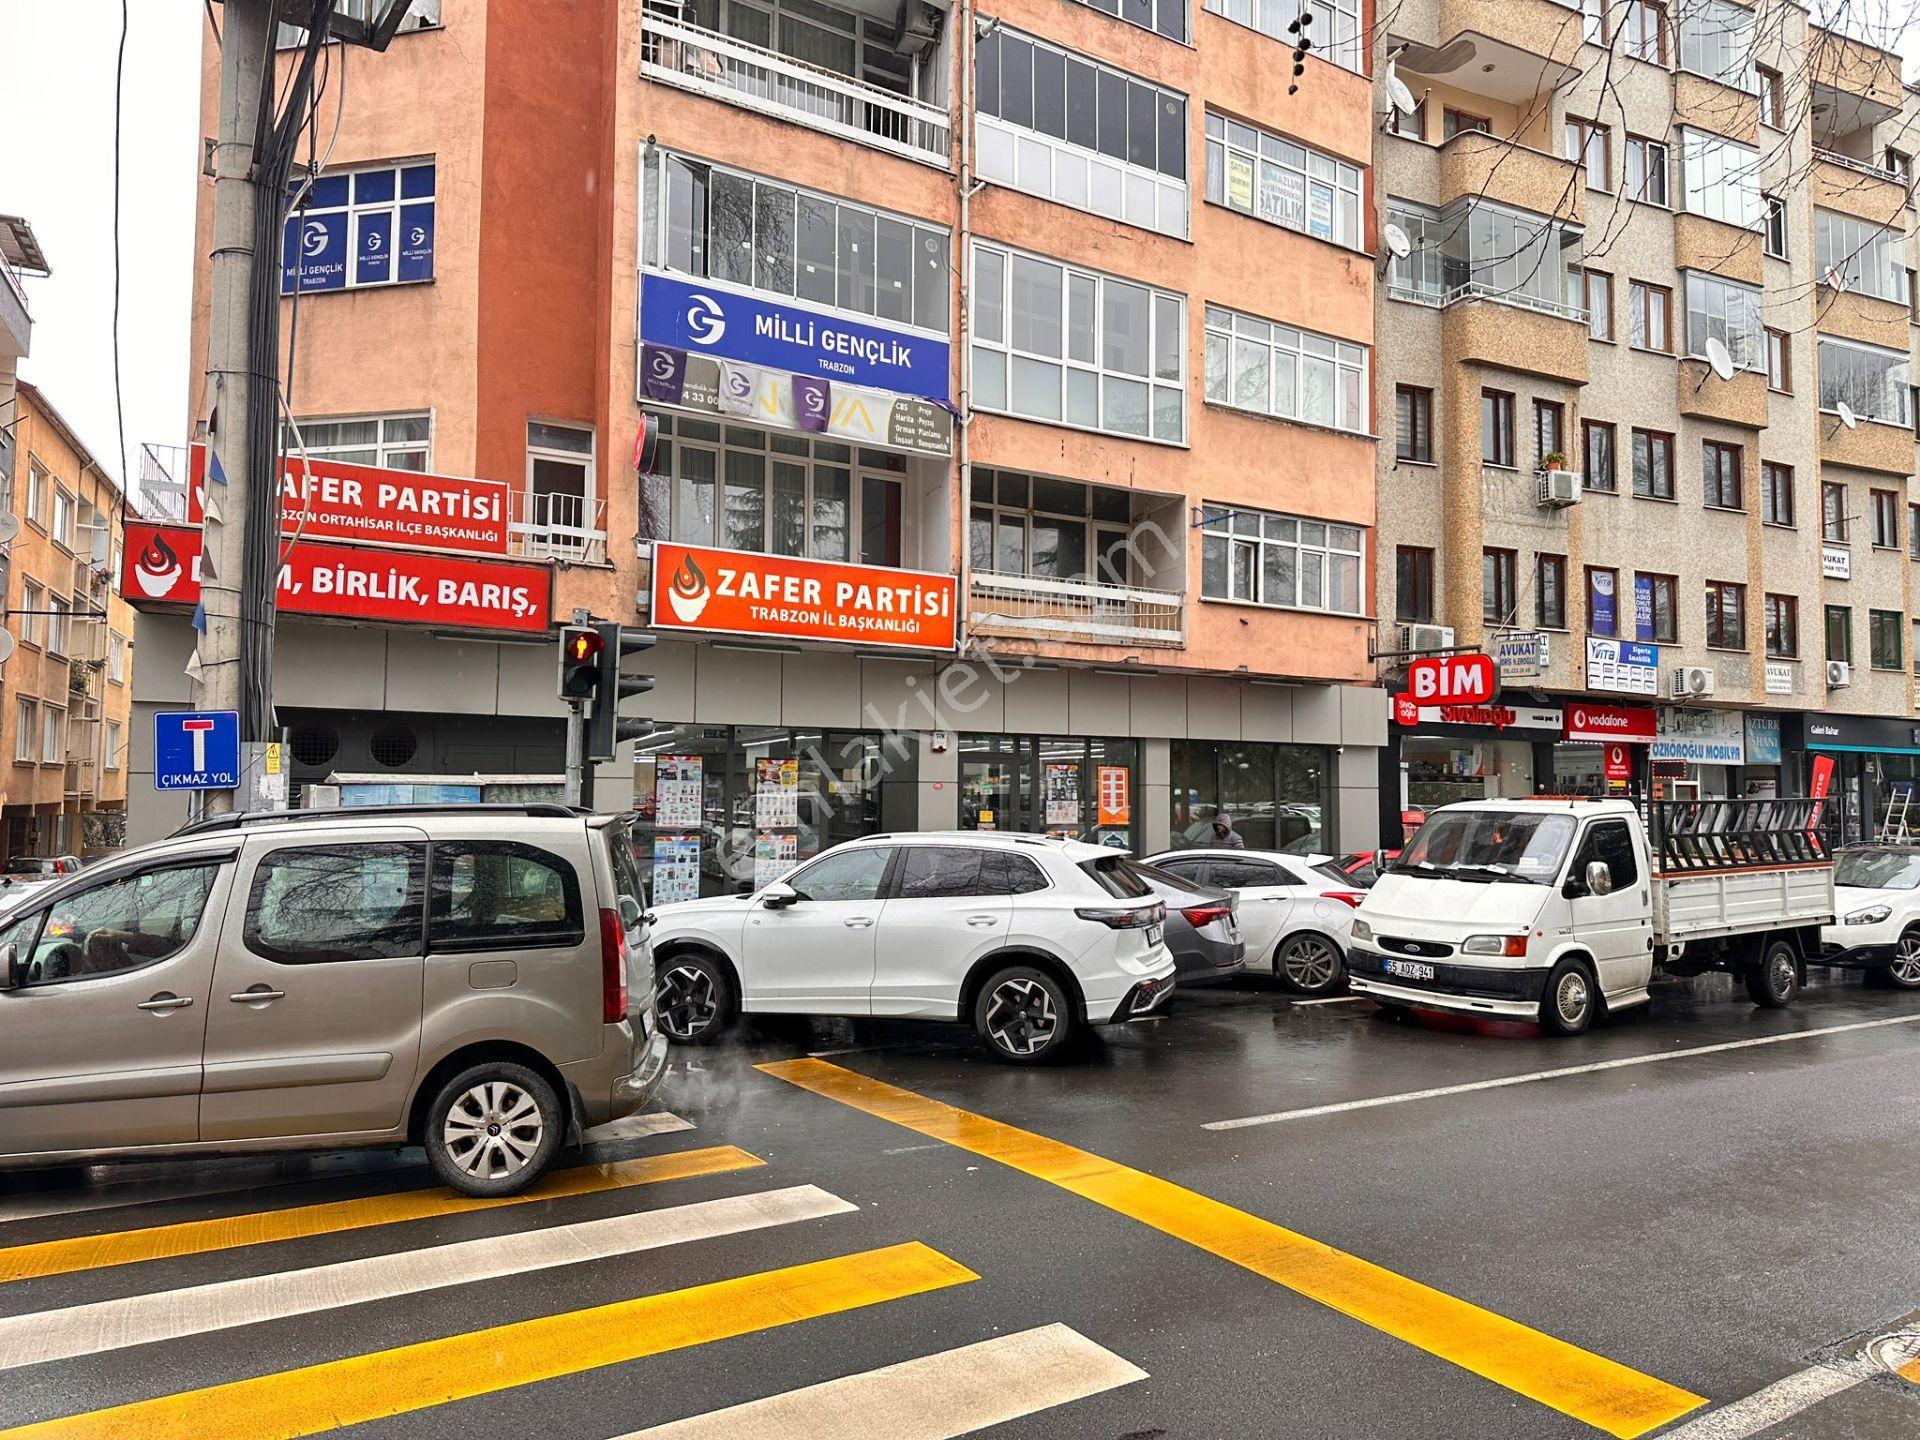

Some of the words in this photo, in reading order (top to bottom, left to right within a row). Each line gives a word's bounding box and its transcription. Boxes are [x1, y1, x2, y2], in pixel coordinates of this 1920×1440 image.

[309, 262, 343, 275] GENÇLİK
[303, 277, 326, 285] TRABZON
[755, 313, 814, 347] MİLLİ
[821, 330, 912, 368] GENÇLİK
[818, 359, 855, 375] TRABZON
[692, 393, 704, 403] 33
[276, 472, 363, 506] AFER
[378, 483, 500, 522] PARTİSİ
[275, 508, 317, 522] BZON
[319, 513, 394, 531] ORTAHİSAR
[396, 520, 422, 535] İLÇE
[425, 525, 498, 542] BAŞKANLIĞI
[1823, 554, 1845, 564] VUKAT
[312, 562, 428, 606] BİRLİK,
[436, 578, 538, 618] BARIŞ,
[716, 568, 821, 606] ZAFER
[836, 582, 949, 618] PARTİSİ
[750, 605, 820, 625] TRABZON
[822, 610, 835, 626] İL
[838, 615, 920, 633] BAŞKANLIĞI
[1500, 643, 1536, 656] AVUKAT
[1414, 658, 1484, 698] BİM
[1588, 713, 1628, 728] vodafone
[1811, 725, 1825, 735] Galeri
[1705, 741, 1741, 760] MOBİLYA
[161, 773, 207, 787] ÇIKMAZ
[211, 772, 234, 783] YOL
[1419, 966, 1433, 978] 941
